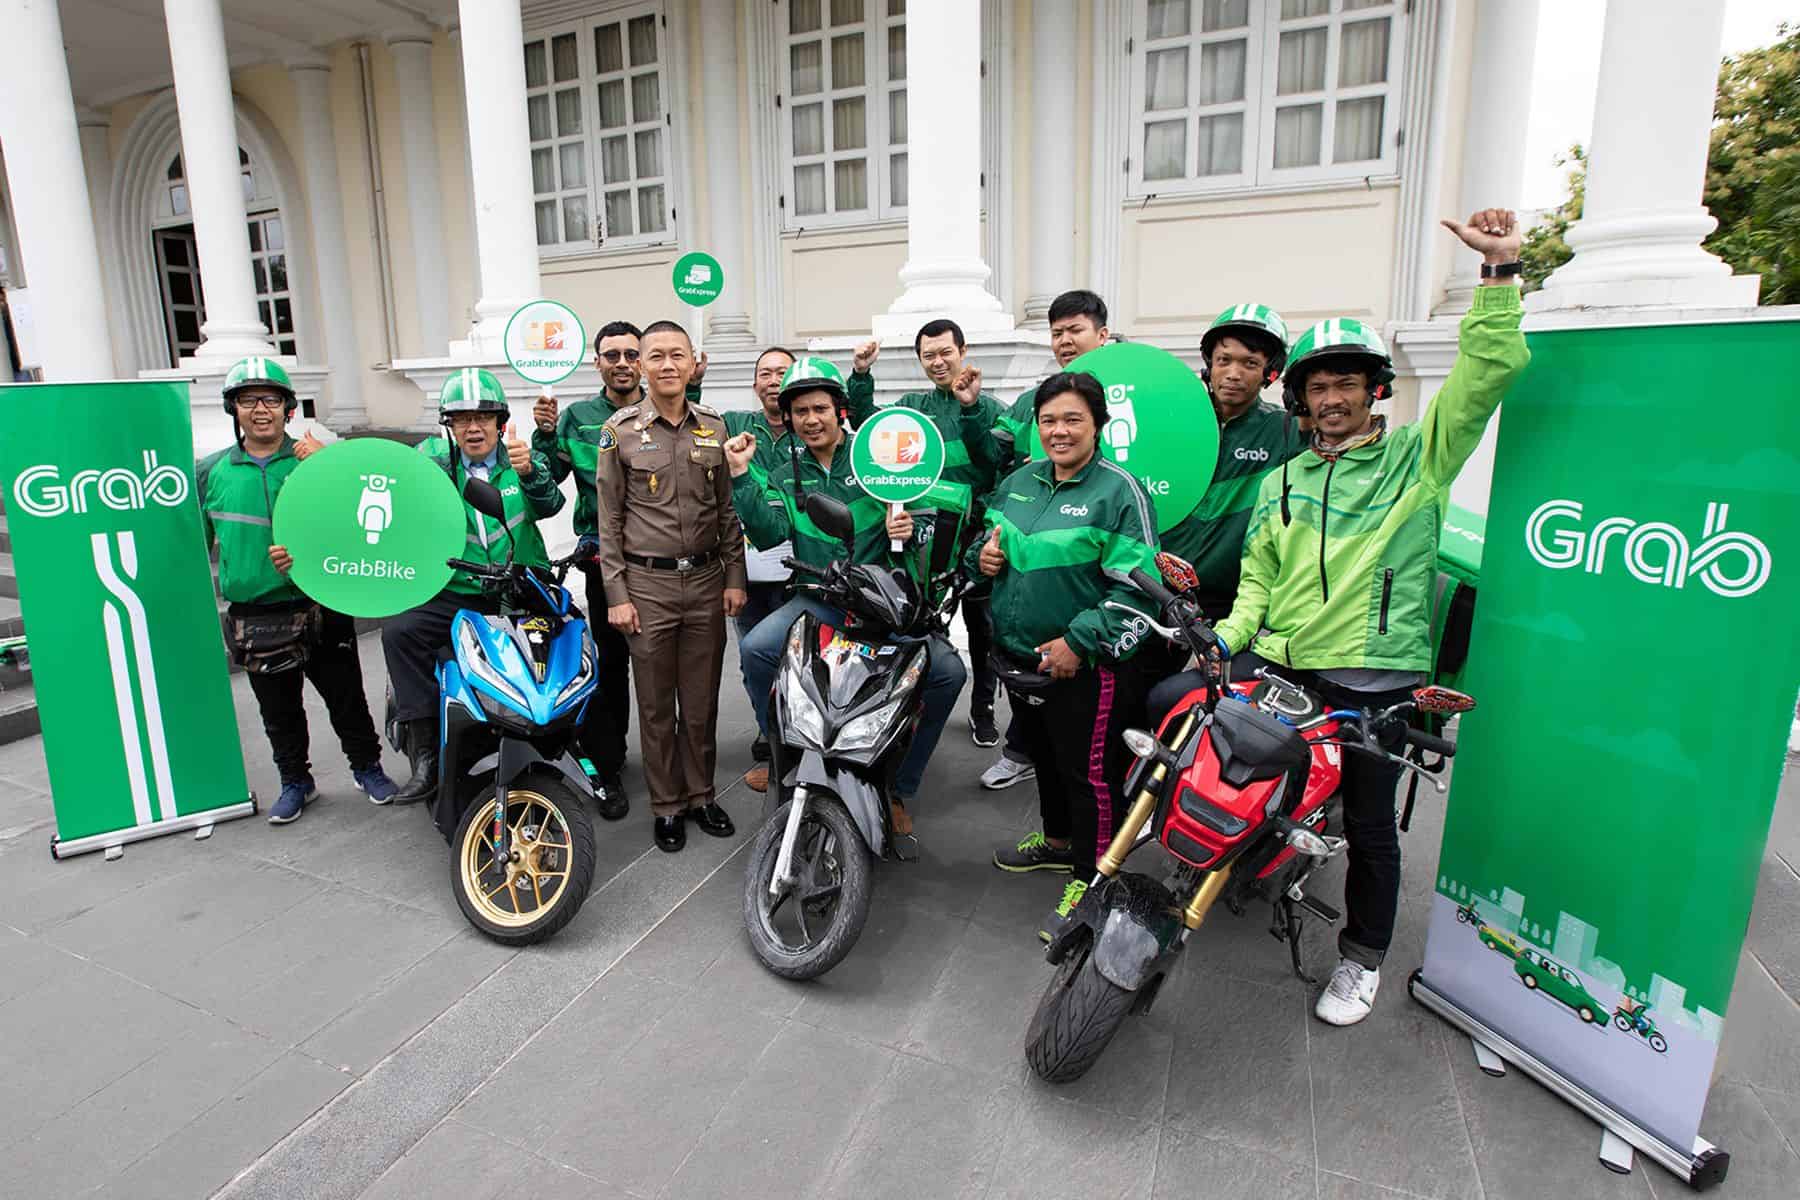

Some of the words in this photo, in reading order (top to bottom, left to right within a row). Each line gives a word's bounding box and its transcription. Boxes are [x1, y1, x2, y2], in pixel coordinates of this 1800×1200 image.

[515, 359, 575, 368] GrabExpress
[1234, 447, 1269, 461] Grab
[13, 449, 189, 518] Grab
[863, 475, 932, 487] GrabExpress
[1060, 504, 1089, 517] Grab
[1525, 499, 1772, 598] Grab
[323, 556, 416, 580] GrabBike
[1103, 616, 1150, 658] rab
